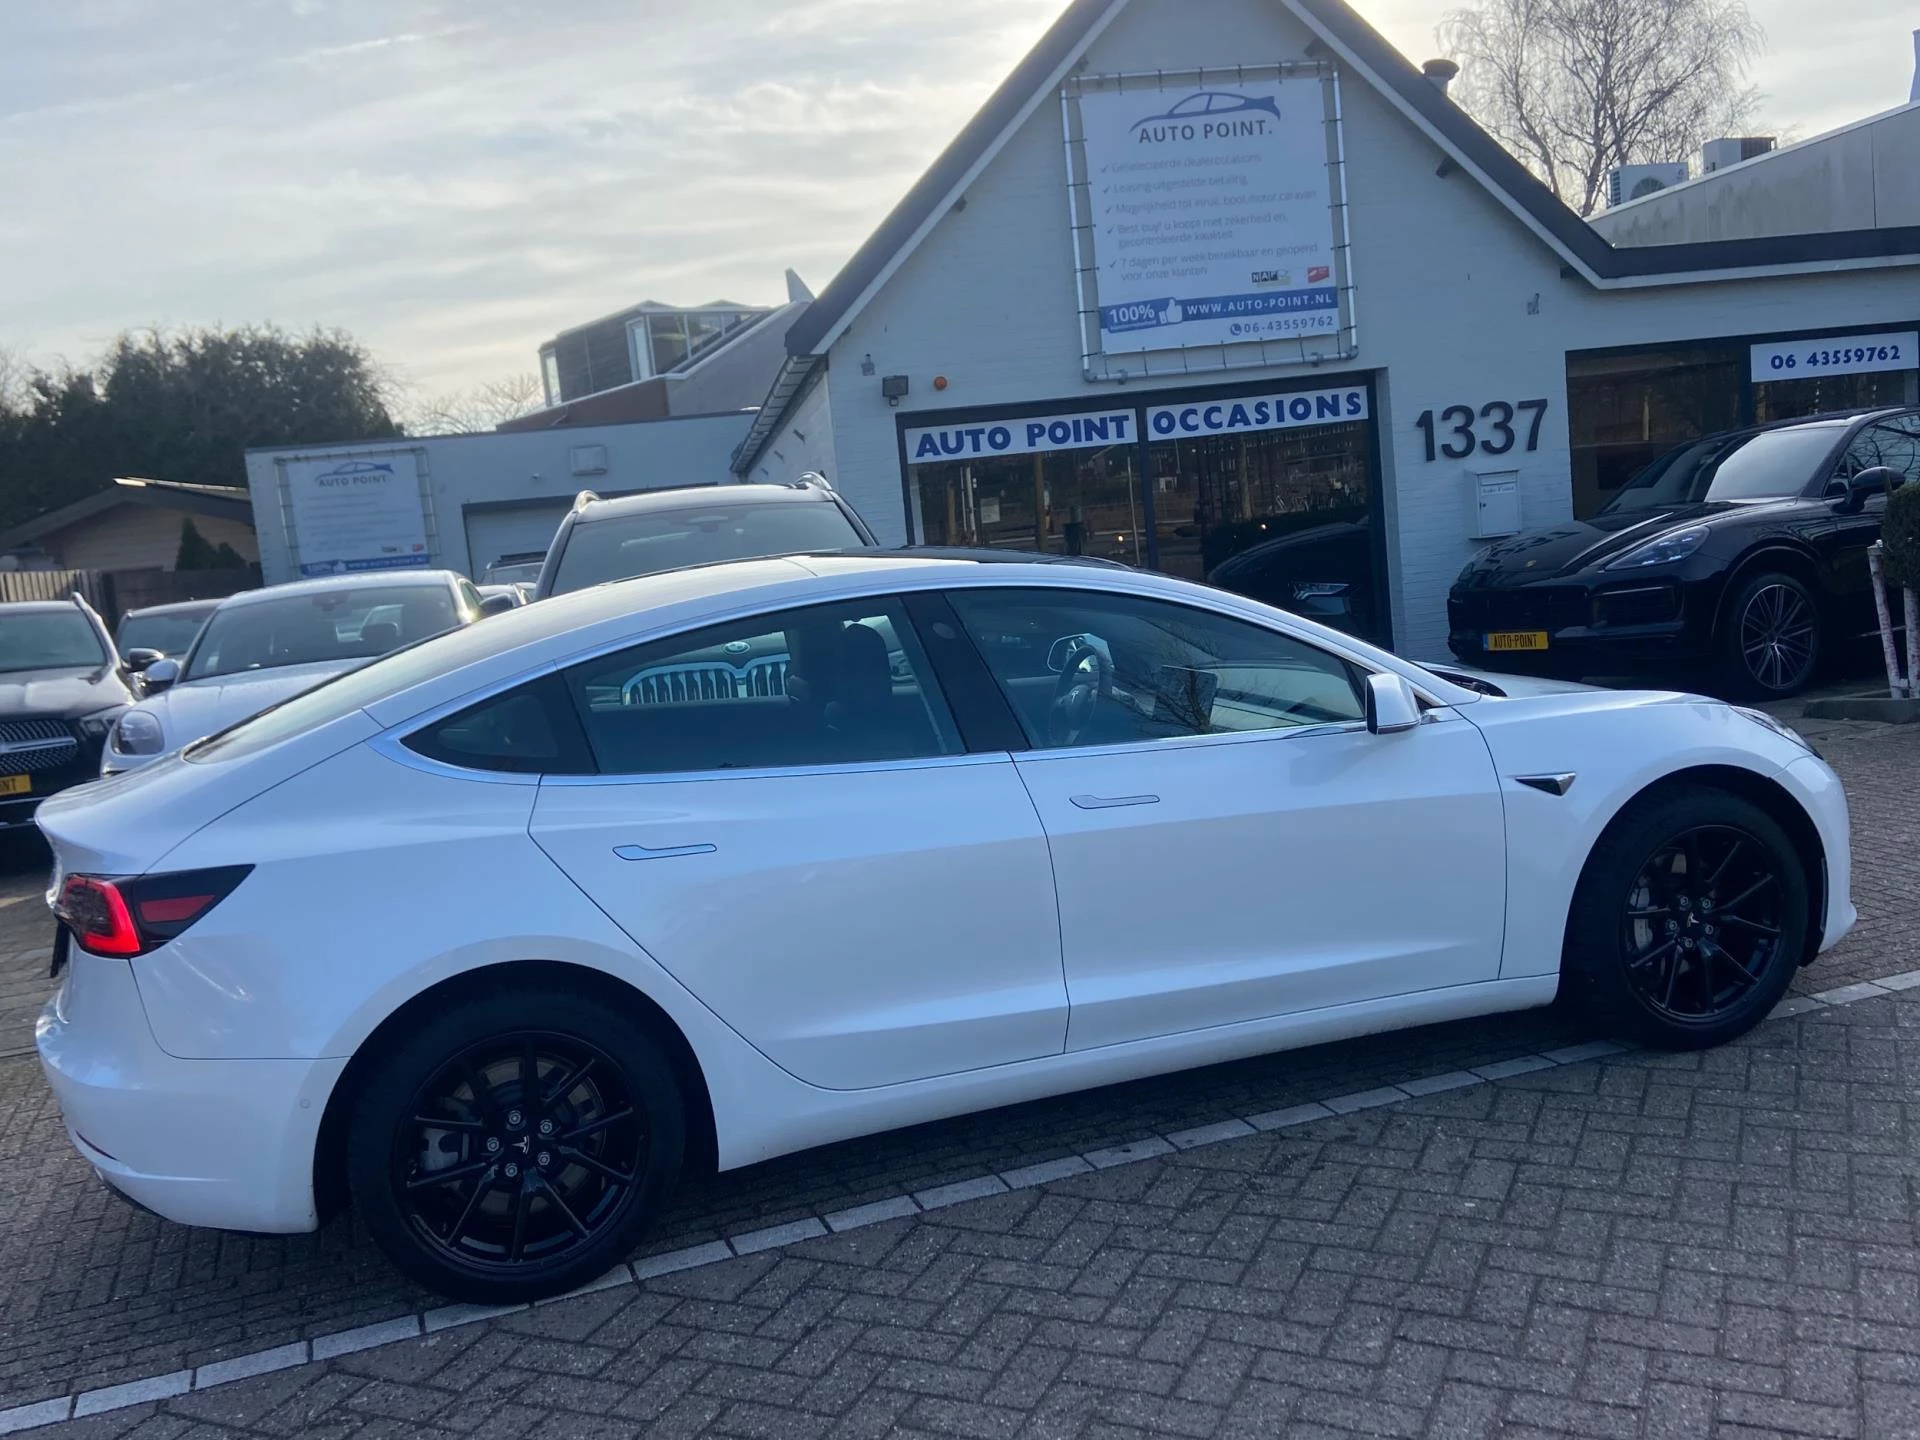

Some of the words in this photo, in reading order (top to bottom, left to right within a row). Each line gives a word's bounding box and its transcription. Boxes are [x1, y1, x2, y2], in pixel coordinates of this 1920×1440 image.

[1139, 124, 1194, 144] AUTO
[1178, 198, 1191, 208] tot
[1118, 224, 1138, 234] Best
[1203, 217, 1222, 227] met
[1120, 258, 1127, 268] 7
[1129, 256, 1160, 269] dagen
[1161, 255, 1177, 266] per
[1181, 252, 1205, 263] week
[1261, 247, 1274, 257] en
[1121, 271, 1142, 281] voor
[1145, 270, 1169, 280] onze
[1171, 266, 1207, 279] klanten
[1109, 304, 1155, 323] 100%
[1187, 296, 1332, 315] WWW.AUTO-POINT.NL
[1244, 316, 1333, 333] 06-43559762
[1771, 354, 1796, 370] 06
[1807, 344, 1900, 367] 43559762
[1153, 392, 1362, 434] OCCASIONS
[915, 427, 1011, 458] AUTO
[1027, 414, 1129, 447] POINT
[1415, 398, 1548, 462] 1337
[319, 477, 349, 488] AUTO
[1494, 634, 1537, 648] AUTO-POINT
